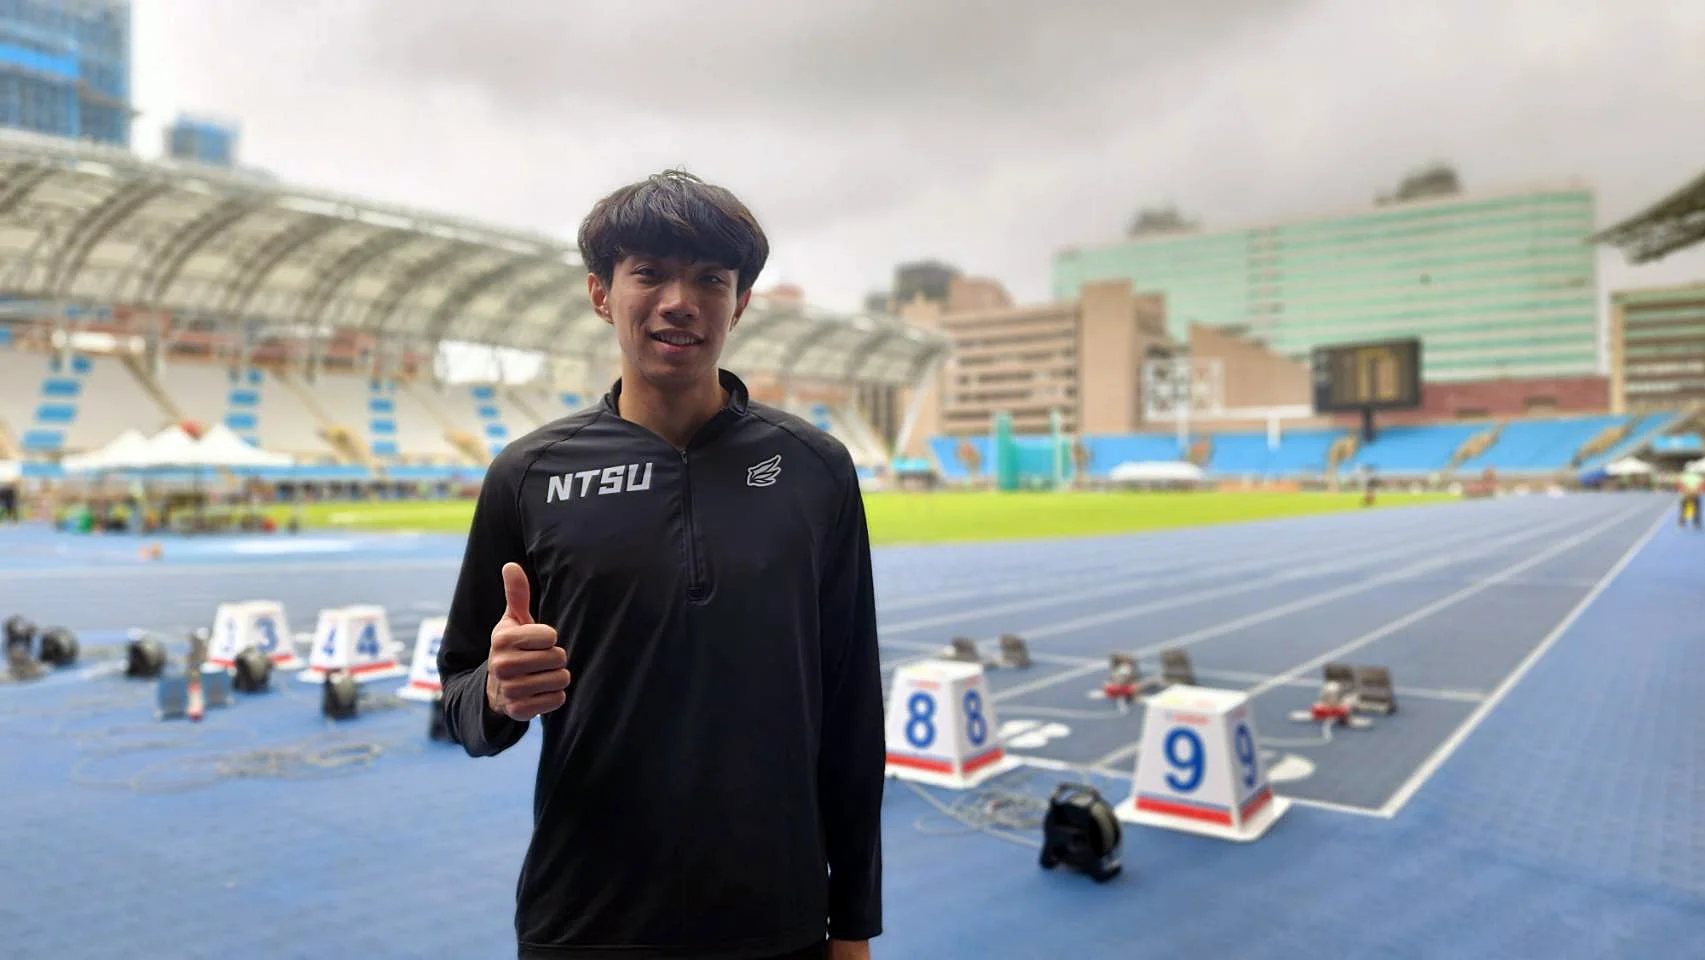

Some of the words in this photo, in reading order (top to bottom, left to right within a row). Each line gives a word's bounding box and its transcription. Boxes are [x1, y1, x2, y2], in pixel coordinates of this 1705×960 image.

[546, 462, 654, 503] NTSU
[256, 618, 279, 652] 3
[355, 623, 381, 656] 4
[905, 691, 936, 749] 8
[963, 689, 987, 746] 8
[1163, 726, 1206, 793] 9
[1234, 722, 1257, 788] 9
